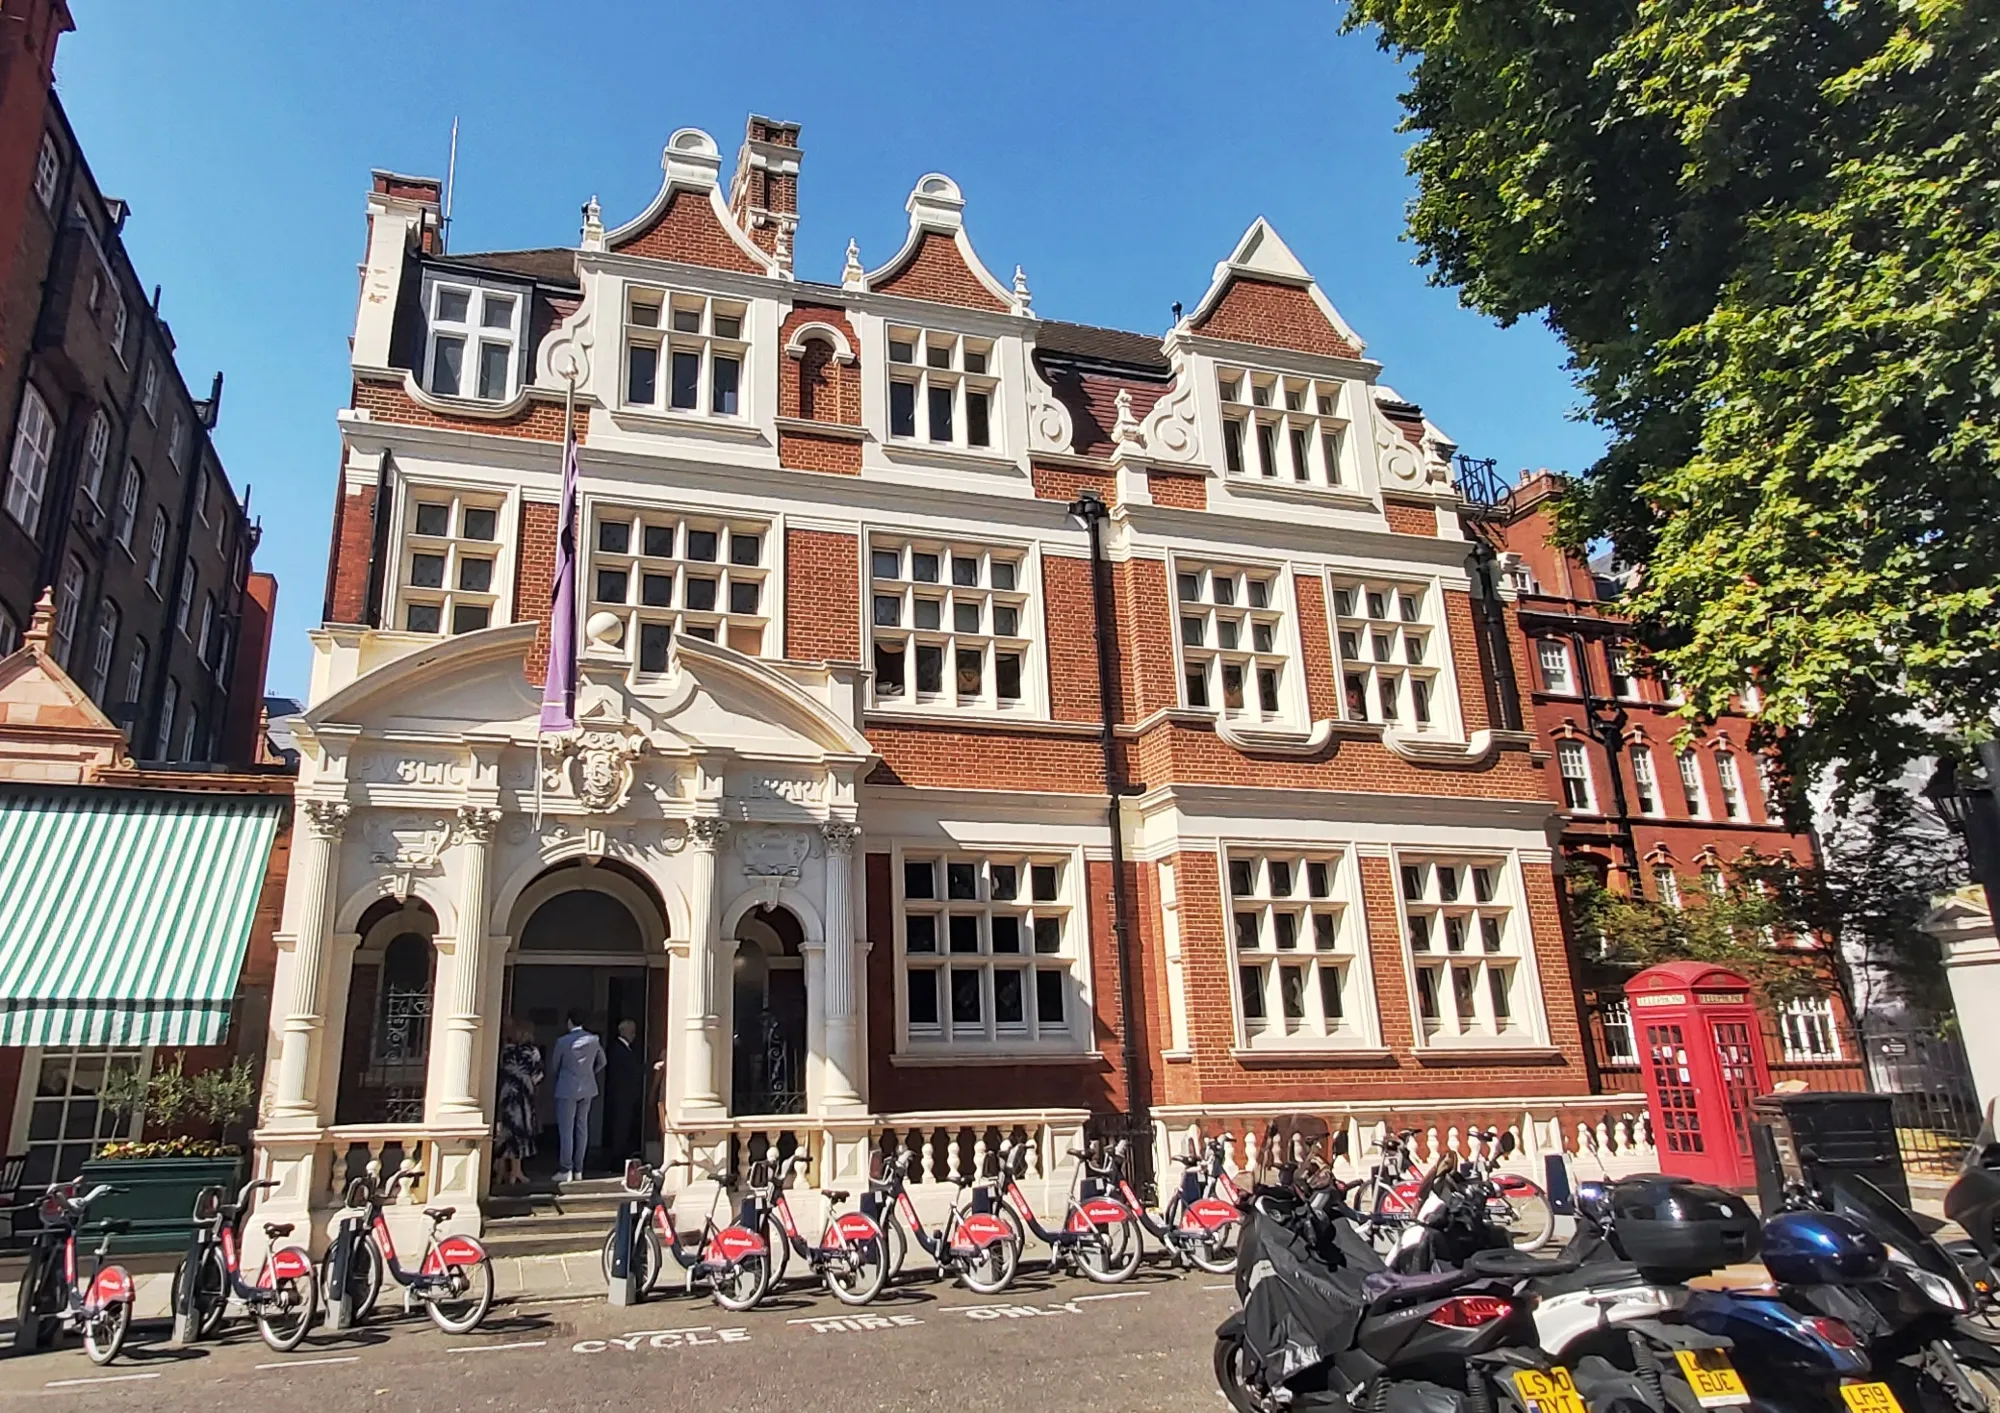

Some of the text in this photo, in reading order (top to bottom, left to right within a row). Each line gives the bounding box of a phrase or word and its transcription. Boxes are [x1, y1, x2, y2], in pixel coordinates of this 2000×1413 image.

[724, 776, 827, 803] BRARY
[571, 1300, 1083, 1355] CYCLE HIRE ONLY
[1847, 1385, 1889, 1406] LF19
